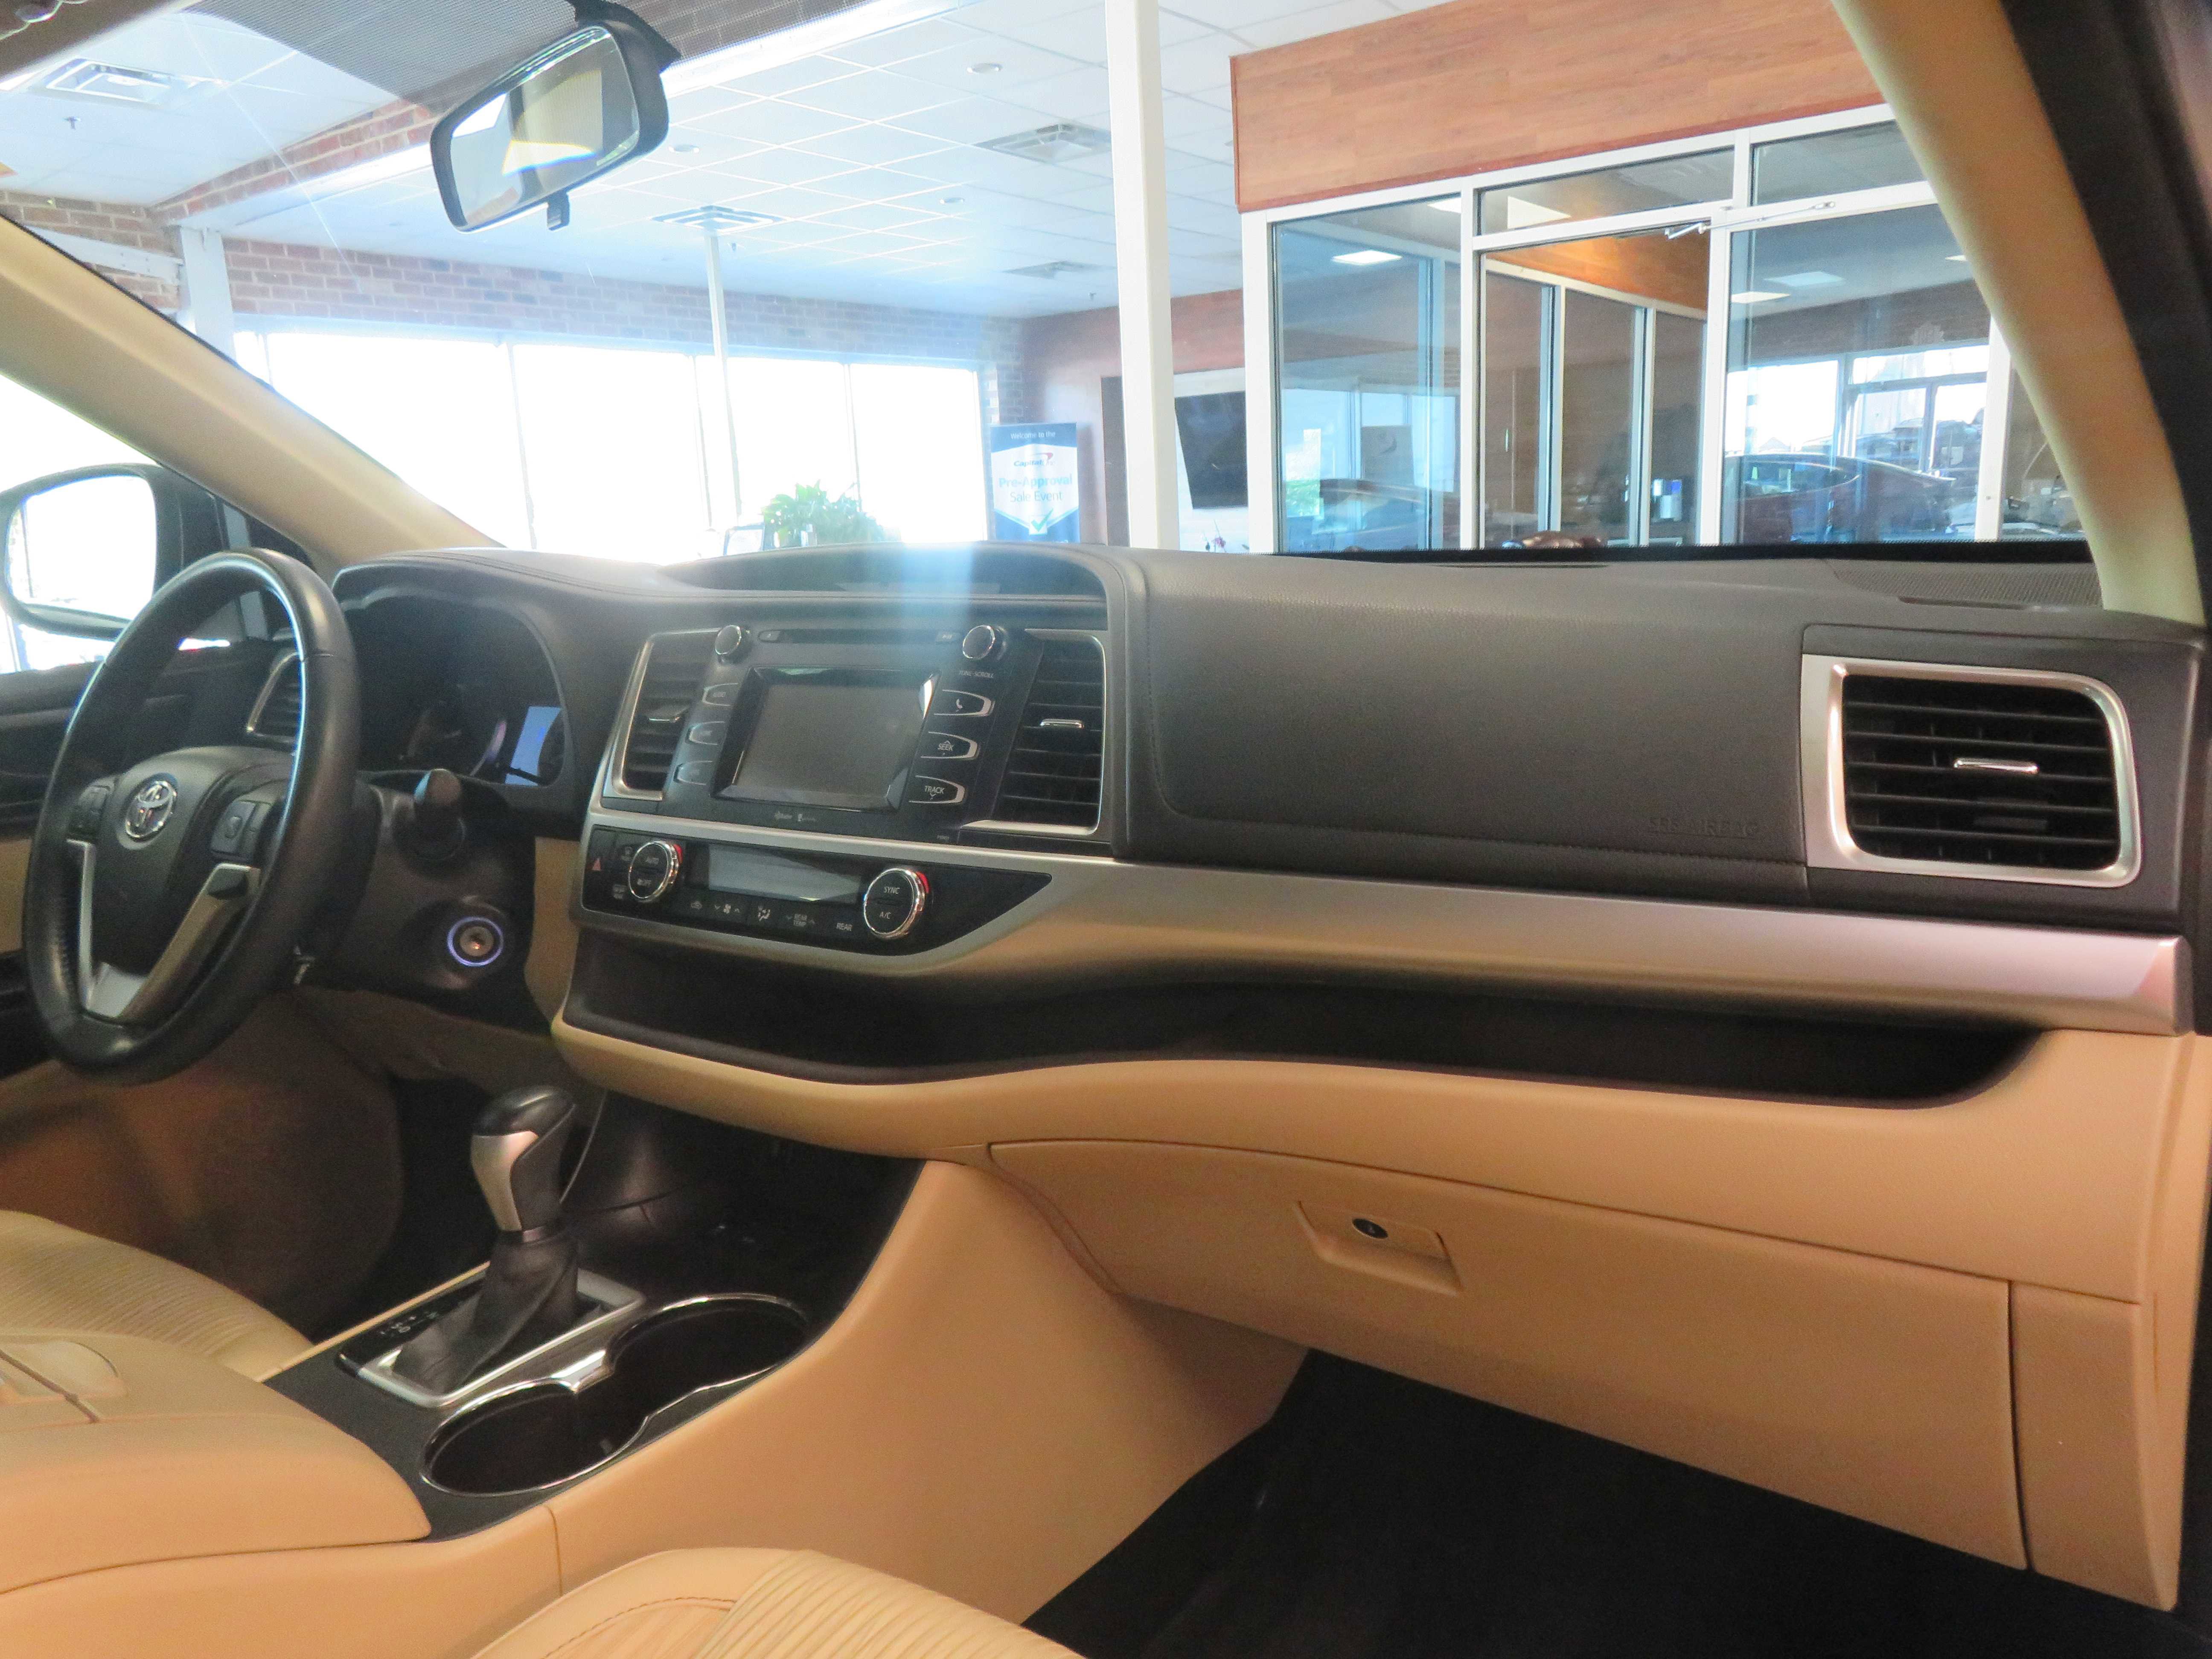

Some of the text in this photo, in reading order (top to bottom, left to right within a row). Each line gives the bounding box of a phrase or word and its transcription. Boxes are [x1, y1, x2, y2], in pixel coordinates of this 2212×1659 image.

[998, 473, 1072, 489] Pre-Approval
[1010, 491, 1062, 503] Sale Event
[925, 785, 945, 794] TRACK
[884, 886, 900, 894] SYNC
[836, 922, 853, 931] REAR
